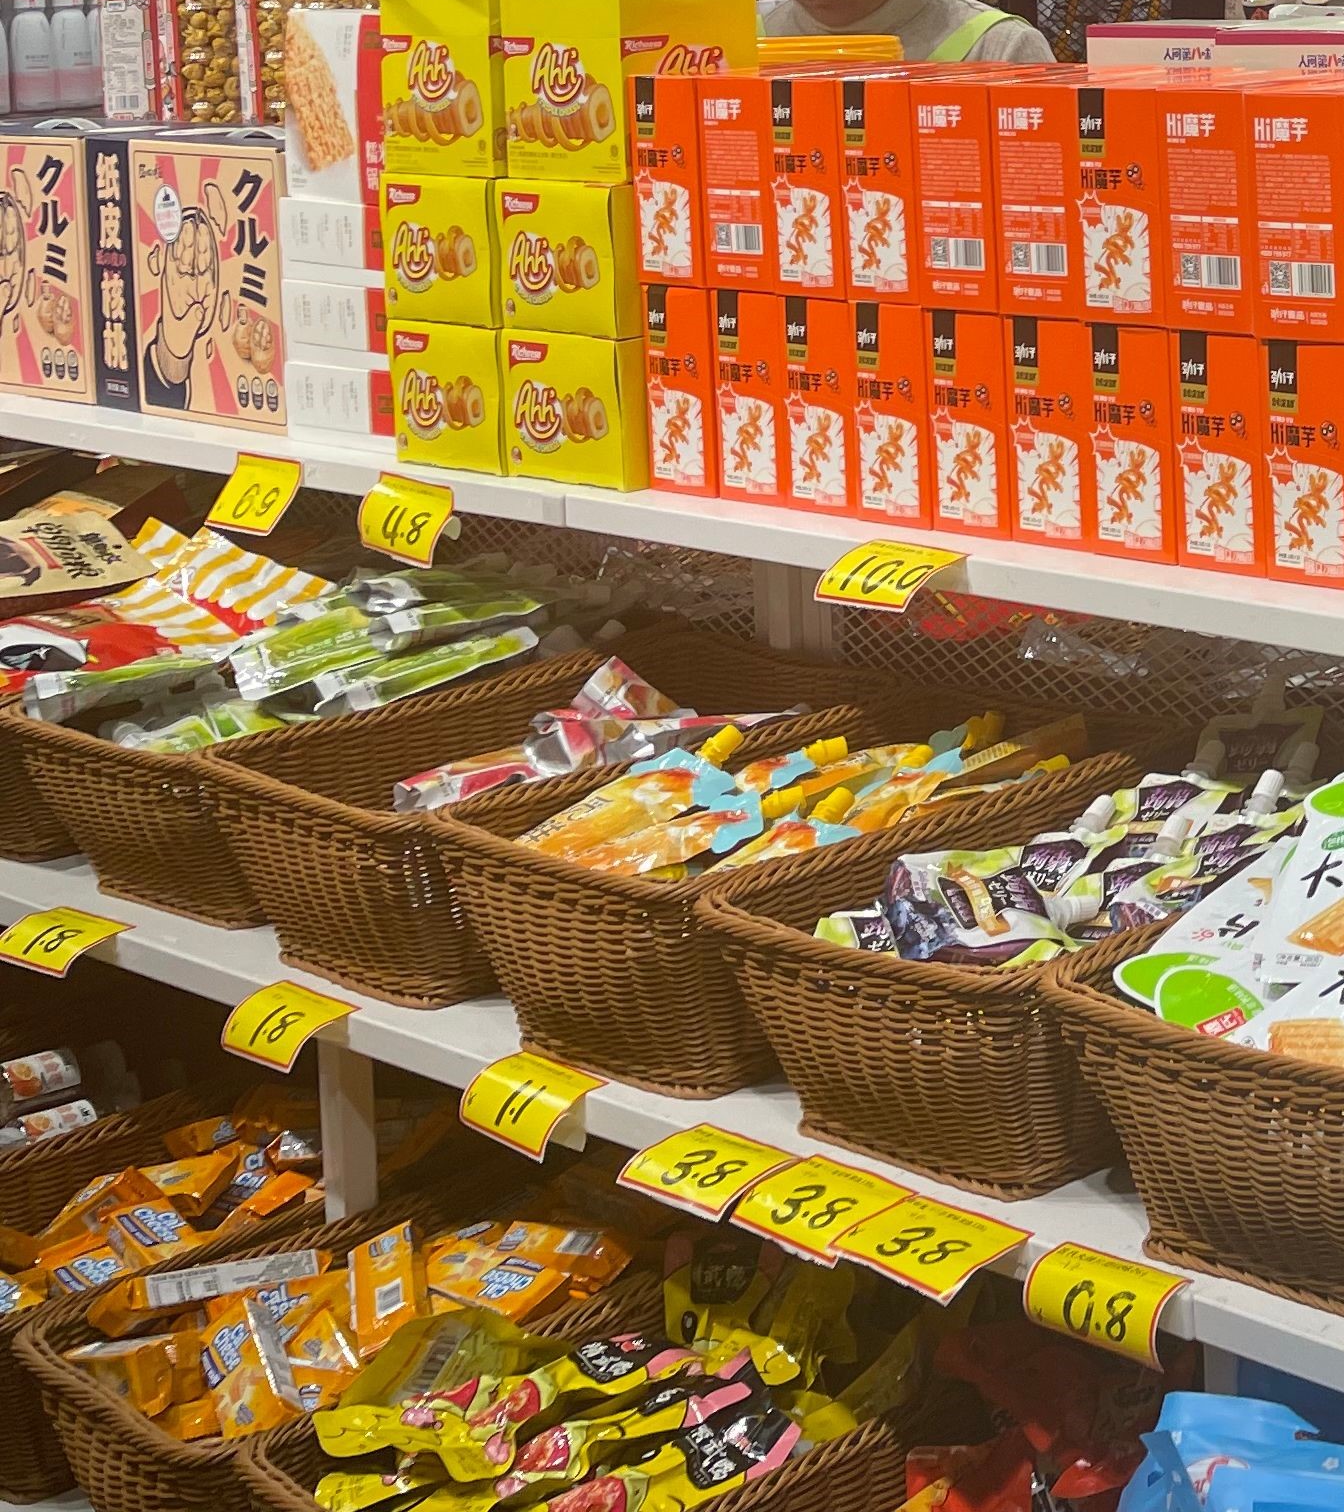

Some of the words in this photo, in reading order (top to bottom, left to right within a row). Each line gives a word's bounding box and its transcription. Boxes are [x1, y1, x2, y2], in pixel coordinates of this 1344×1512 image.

[35, 154, 69, 285] クルミ
[232, 169, 269, 308] クルミ
[381, 505, 432, 547] 4.8
[837, 554, 938, 593] 10.0
[22, 927, 84, 955] 1.8
[249, 1004, 306, 1047] 1.8
[660, 1148, 750, 1188] 3.8
[769, 1184, 860, 1230] 3.8
[874, 1225, 975, 1265] 3.8
[1062, 1279, 1138, 1343] 0.8
